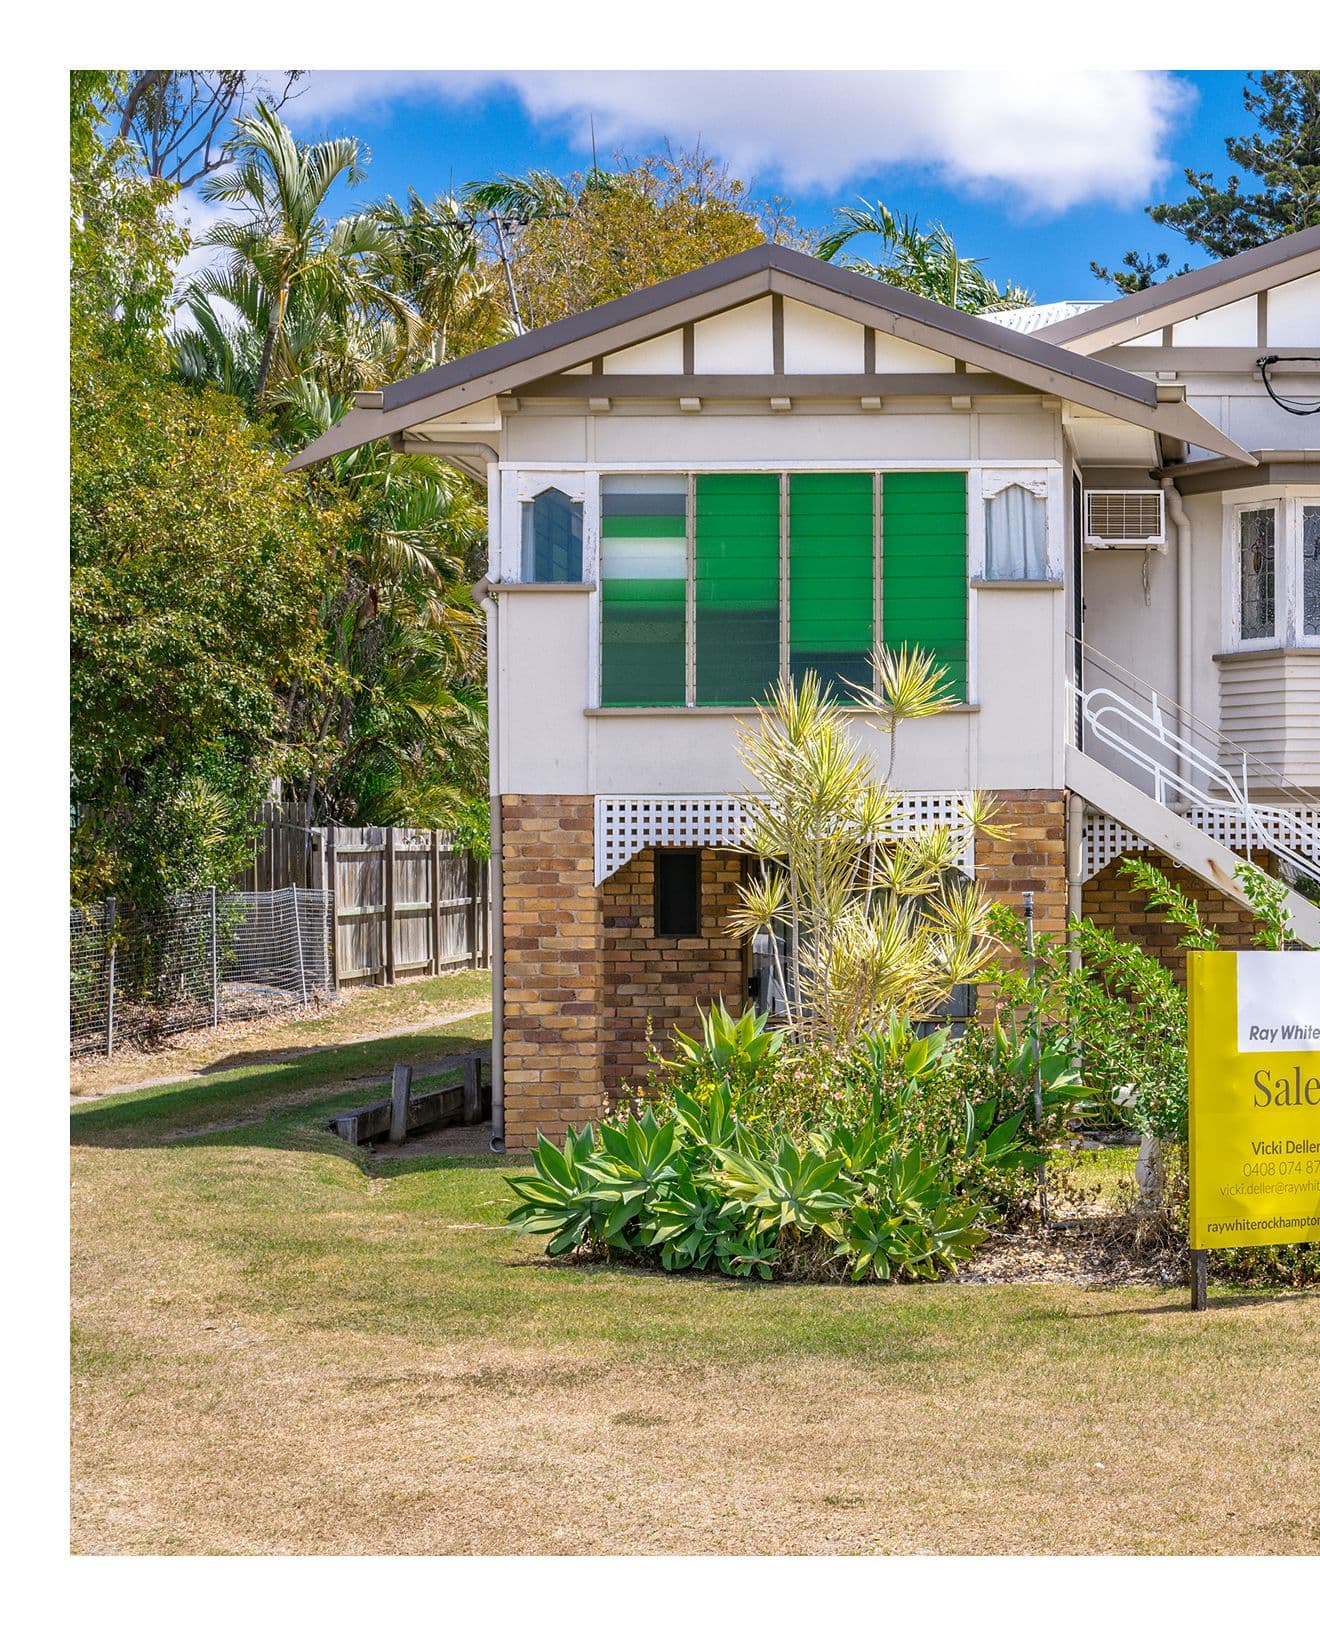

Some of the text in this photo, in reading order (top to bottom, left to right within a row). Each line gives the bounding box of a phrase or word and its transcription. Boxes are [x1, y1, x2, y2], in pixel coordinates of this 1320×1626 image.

[1249, 1024, 1320, 1043] Ray White
[1251, 1140, 1283, 1156] Vicki
[1243, 1162, 1276, 1178] 0408
[1278, 1161, 1302, 1176] 074
